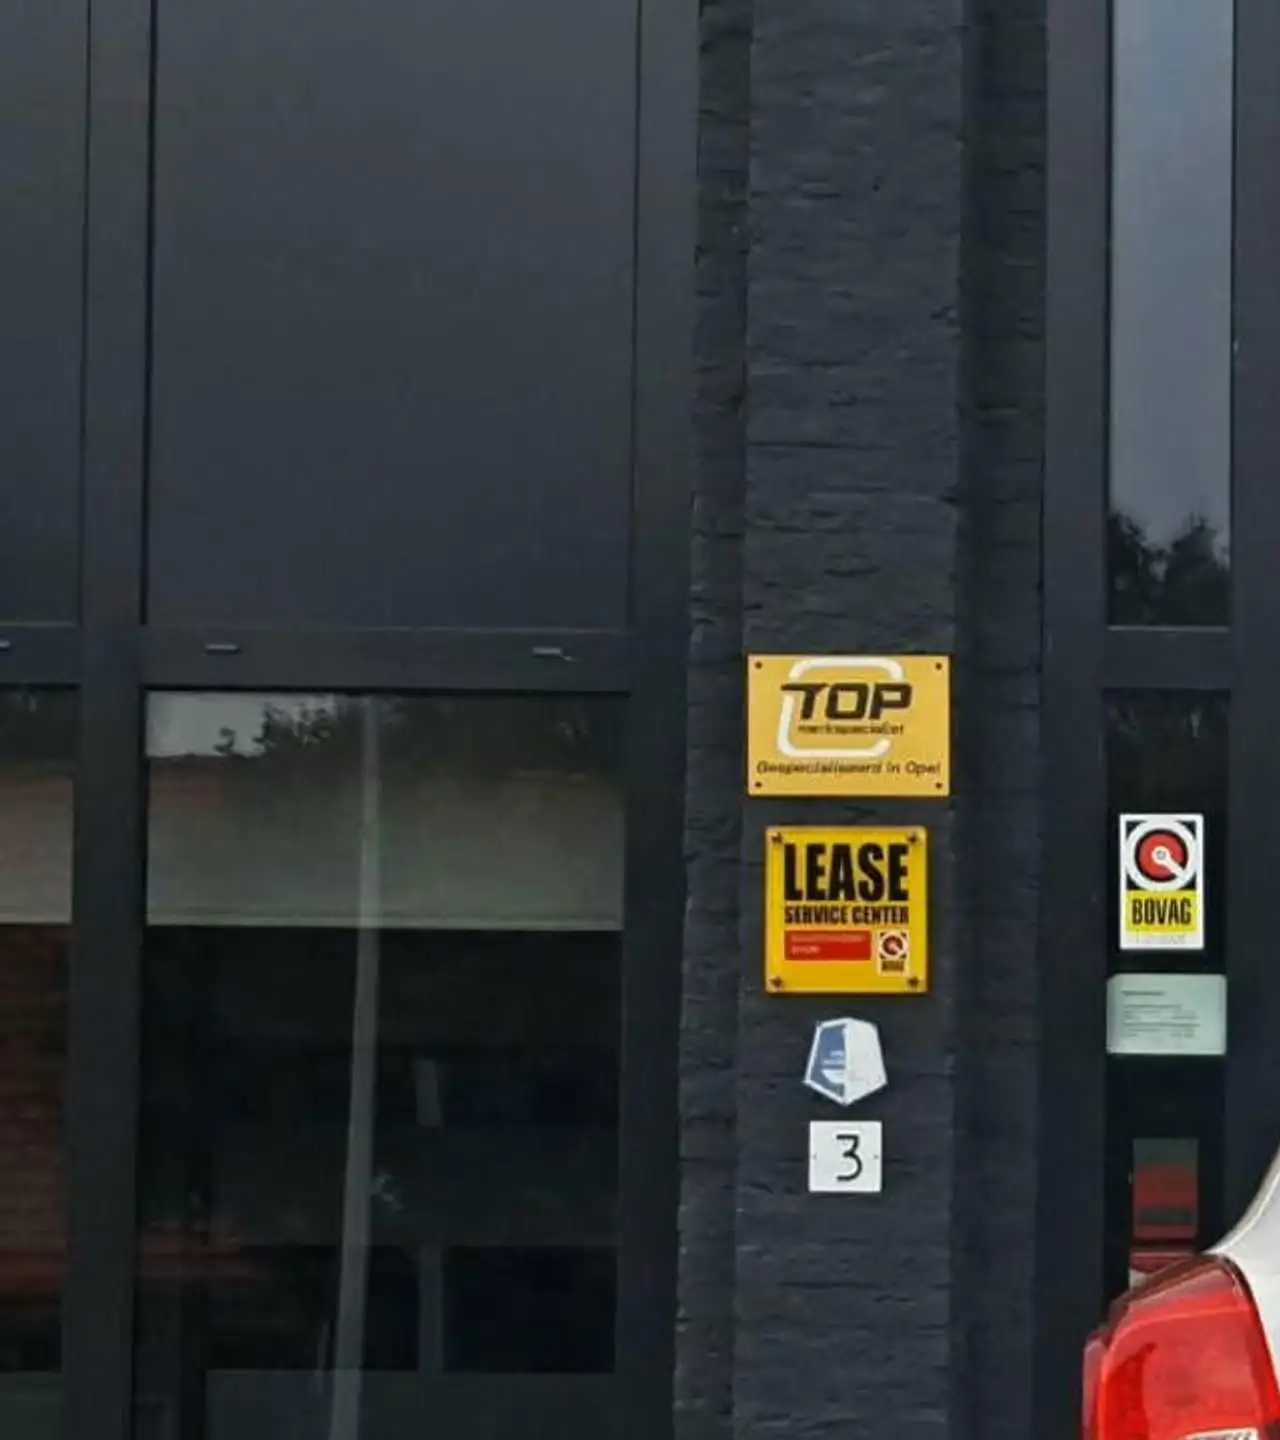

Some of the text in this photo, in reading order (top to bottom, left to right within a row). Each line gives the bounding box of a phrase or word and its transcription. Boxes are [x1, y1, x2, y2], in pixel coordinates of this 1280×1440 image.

[780, 682, 912, 720] TOP
[905, 760, 941, 778] Opel
[784, 843, 909, 901] LEASE
[784, 905, 909, 924] SERVICE CENTER
[1131, 898, 1192, 925] BOVAG
[836, 1133, 862, 1182] 3
